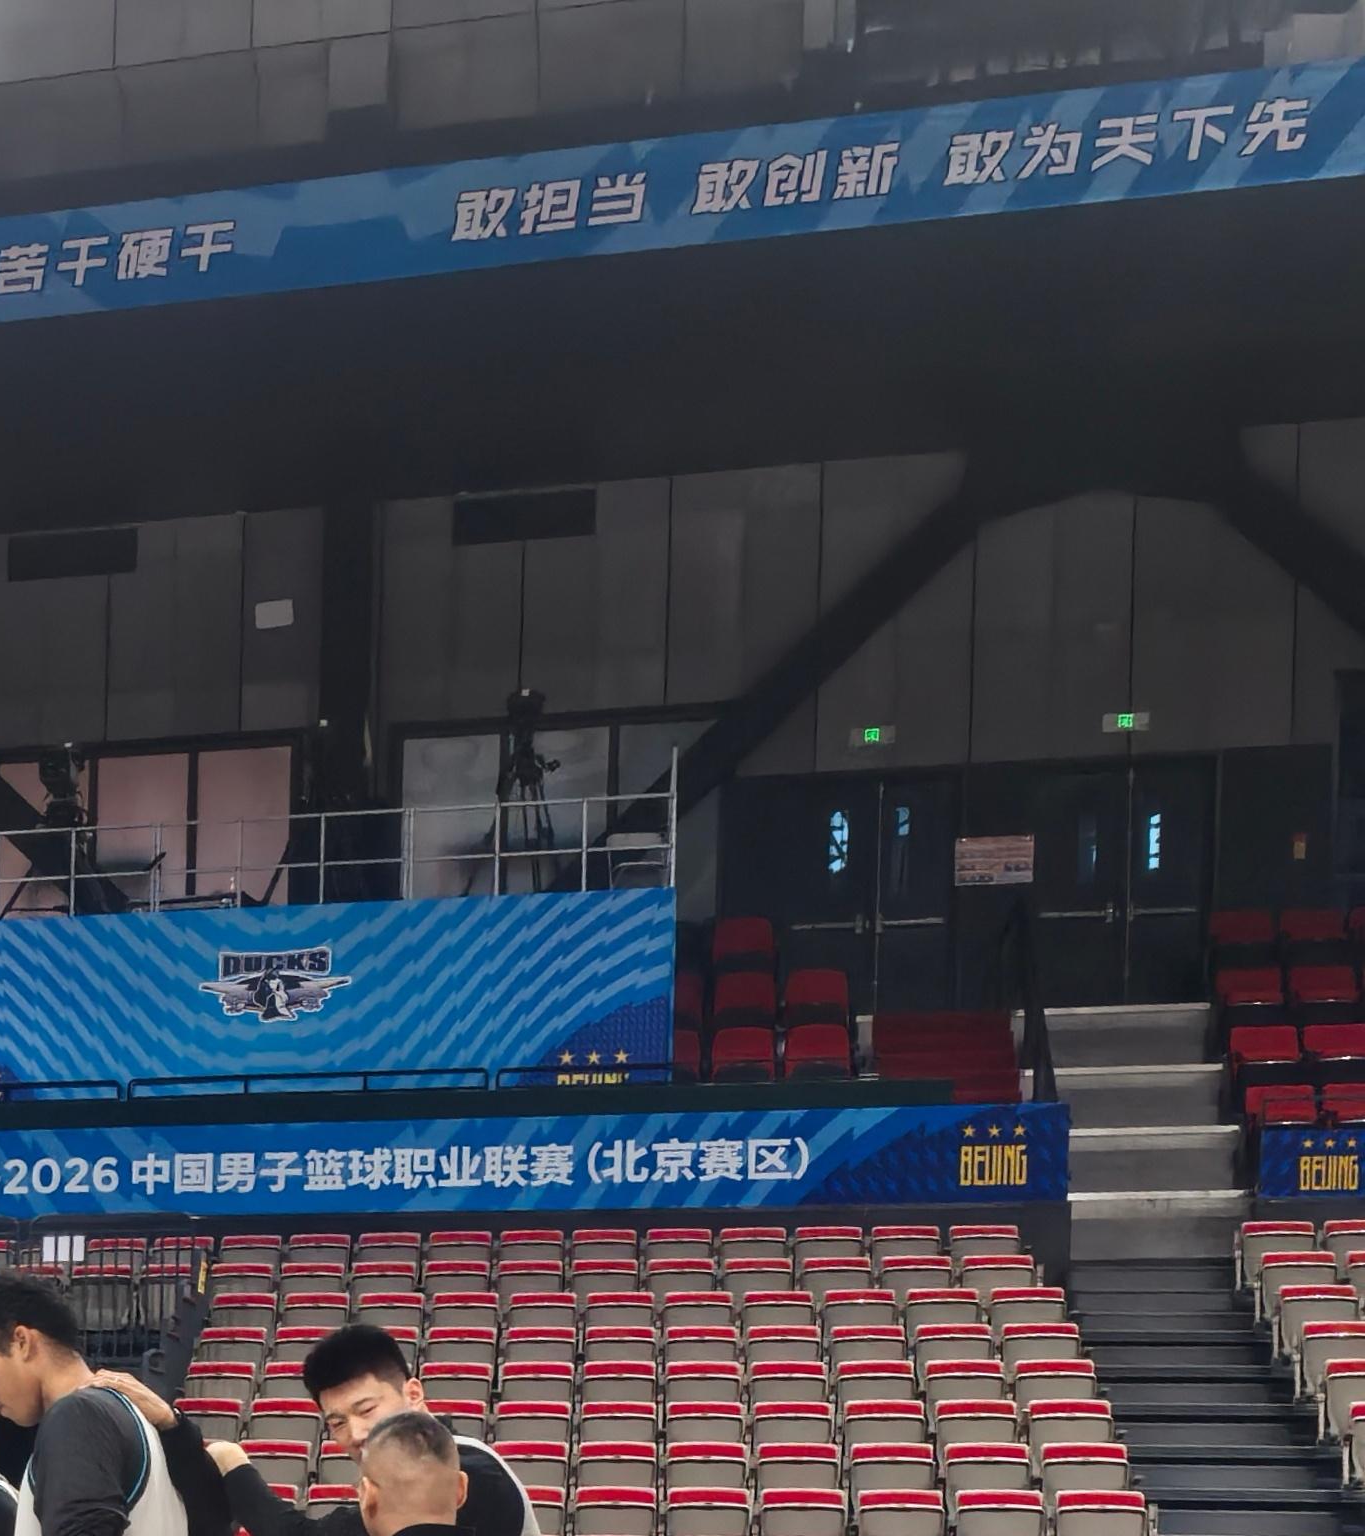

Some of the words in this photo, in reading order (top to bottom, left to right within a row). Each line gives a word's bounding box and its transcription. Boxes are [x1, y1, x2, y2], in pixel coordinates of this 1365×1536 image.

[451, 171, 647, 243] 敢担当
[690, 142, 901, 214] 敢创新
[945, 96, 1310, 188] 敢为天下先
[222, 949, 329, 978] DUCKS
[959, 1144, 1028, 1186] BEIJING
[1299, 1155, 1359, 1191] BEIJING
